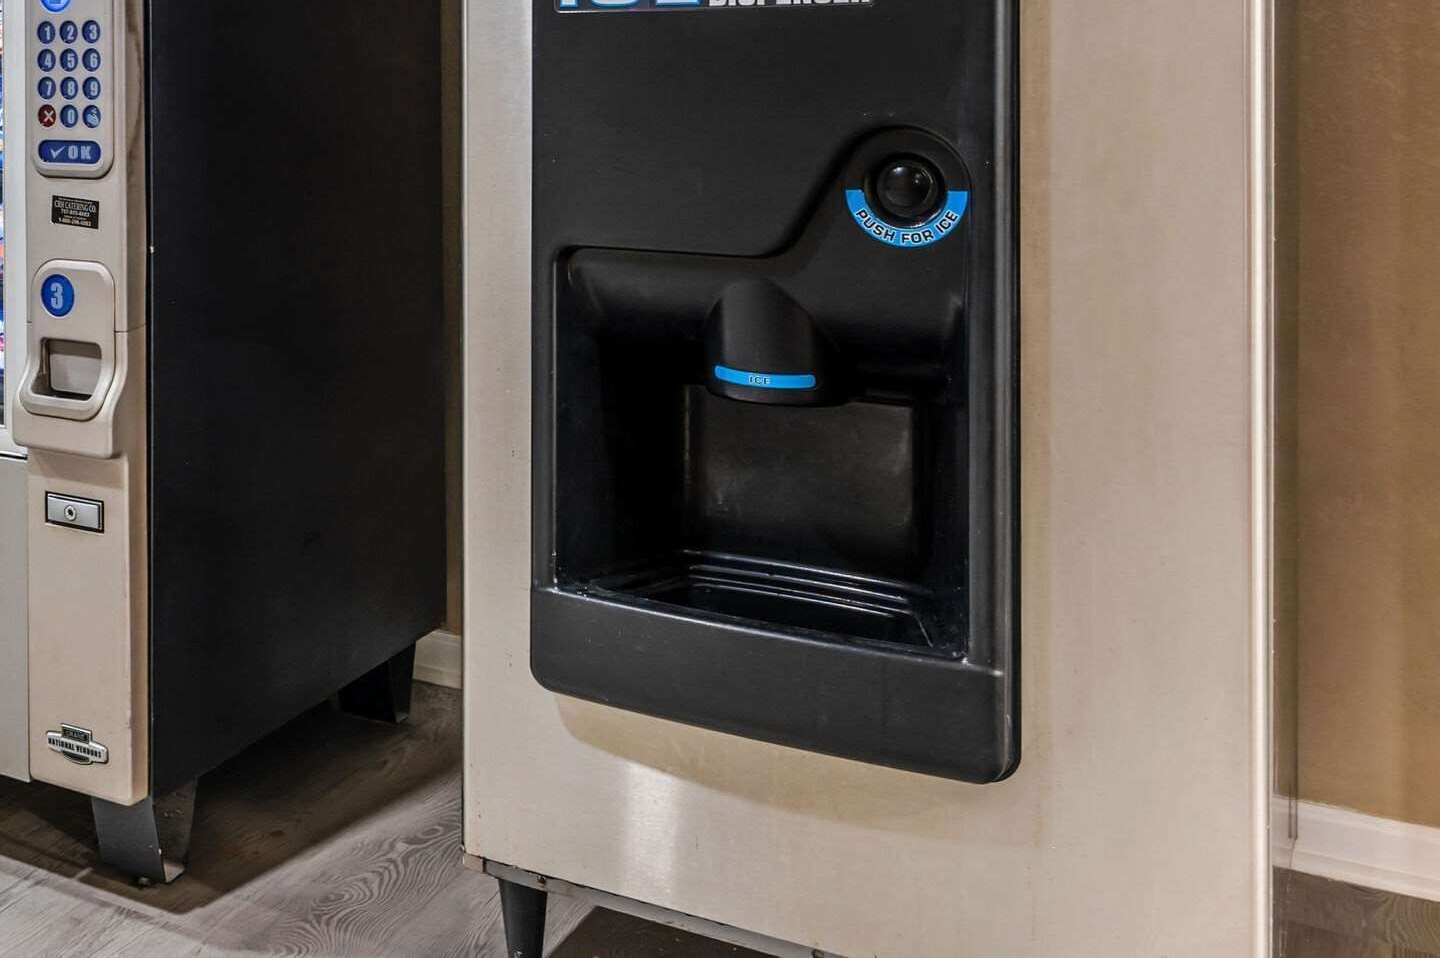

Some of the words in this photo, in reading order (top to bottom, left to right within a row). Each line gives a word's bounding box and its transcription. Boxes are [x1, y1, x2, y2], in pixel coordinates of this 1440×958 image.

[44, 26, 51, 40] 1
[66, 26, 74, 40] 2
[89, 25, 97, 40] 3
[44, 54, 52, 68] 4
[67, 54, 74, 68] 5
[90, 54, 97, 68] 6
[45, 82, 52, 95] 7
[67, 82, 75, 96] 8
[90, 82, 98, 96] 9
[67, 109, 74, 124] 0
[68, 145, 92, 160] OK
[855, 208, 894, 242] PUSH
[900, 228, 934, 244] FOR
[936, 209, 959, 236] ICE
[50, 282, 64, 309] 3
[748, 375, 771, 386] ICE
[48, 737, 75, 751] NATIONAL
[75, 745, 102, 758] VENDORS
